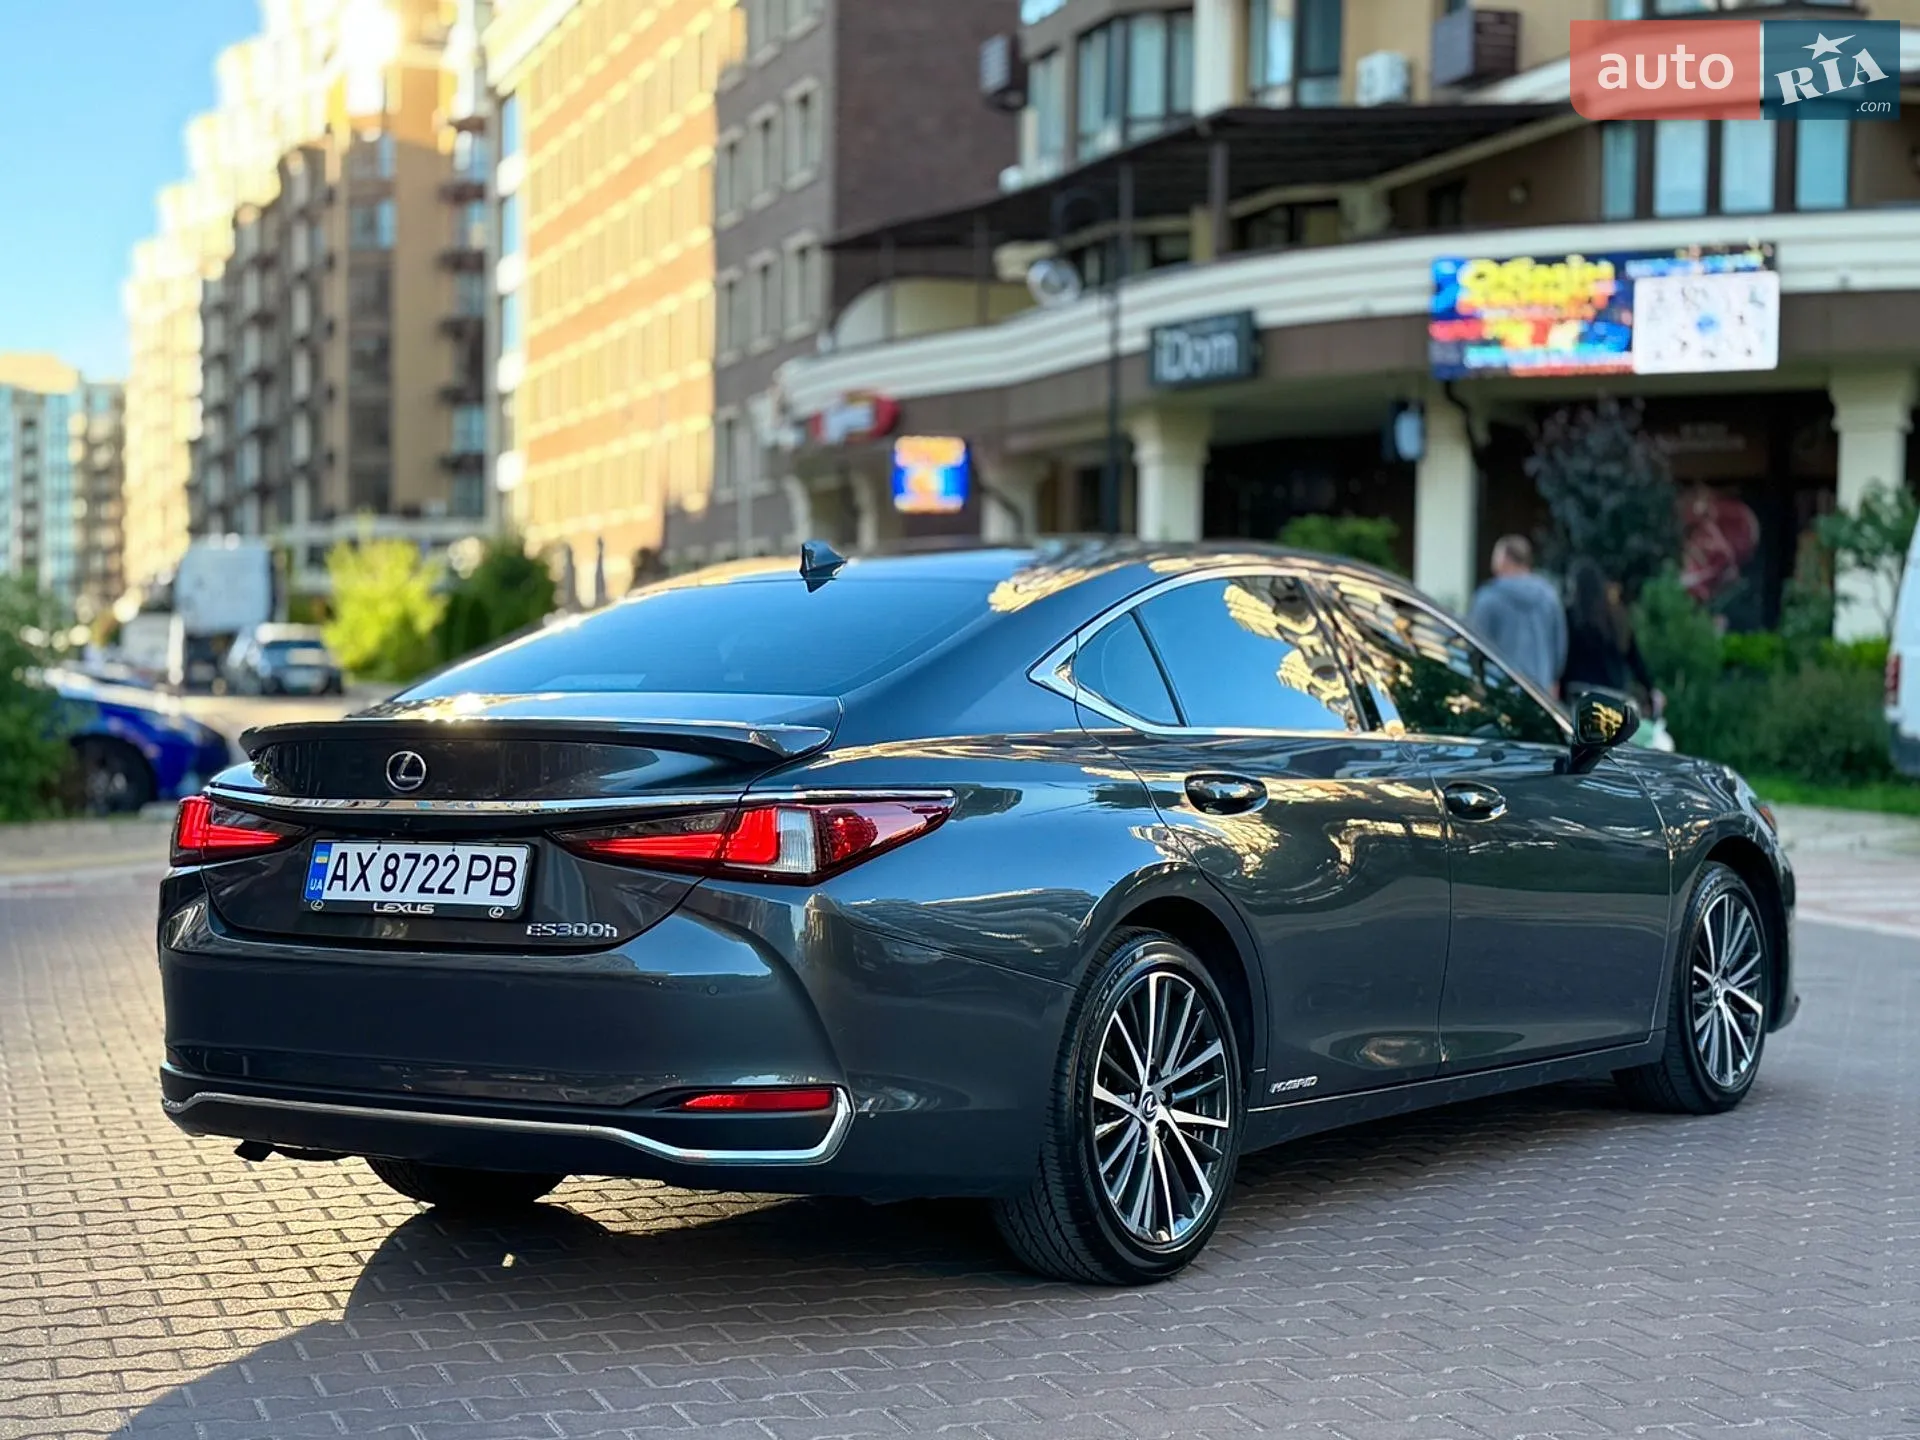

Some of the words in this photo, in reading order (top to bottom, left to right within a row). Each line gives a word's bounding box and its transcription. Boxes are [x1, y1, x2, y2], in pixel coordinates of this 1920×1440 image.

[327, 851, 377, 892] AX
[380, 853, 460, 895] 8722
[464, 854, 517, 897] PB
[309, 879, 323, 891] UA
[373, 902, 435, 915] LEXUS
